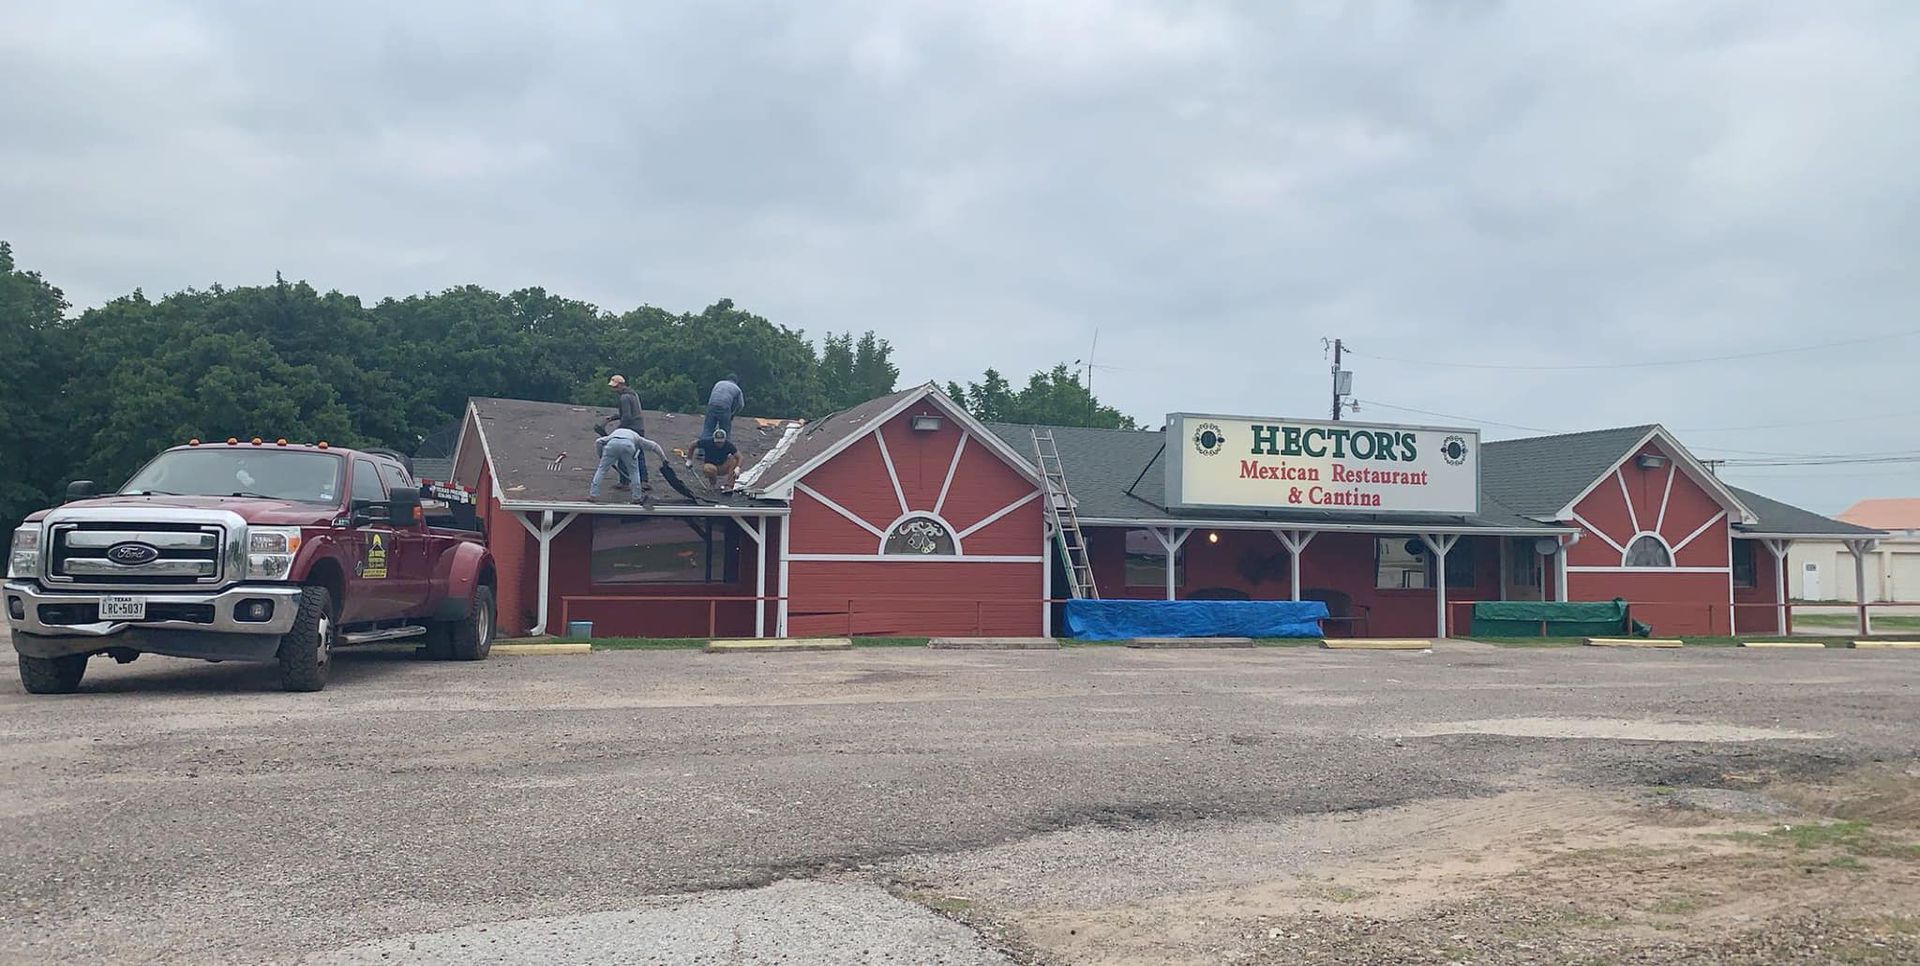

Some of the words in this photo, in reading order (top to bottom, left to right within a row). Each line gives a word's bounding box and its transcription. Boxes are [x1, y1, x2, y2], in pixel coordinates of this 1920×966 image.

[1251, 424, 1417, 462] HECTOR'S
[1239, 460, 1319, 481] Mexican
[1332, 464, 1428, 486] Restaurant
[1288, 486, 1302, 505] &
[1309, 486, 1381, 507] Cantina
[117, 547, 145, 558] Ford
